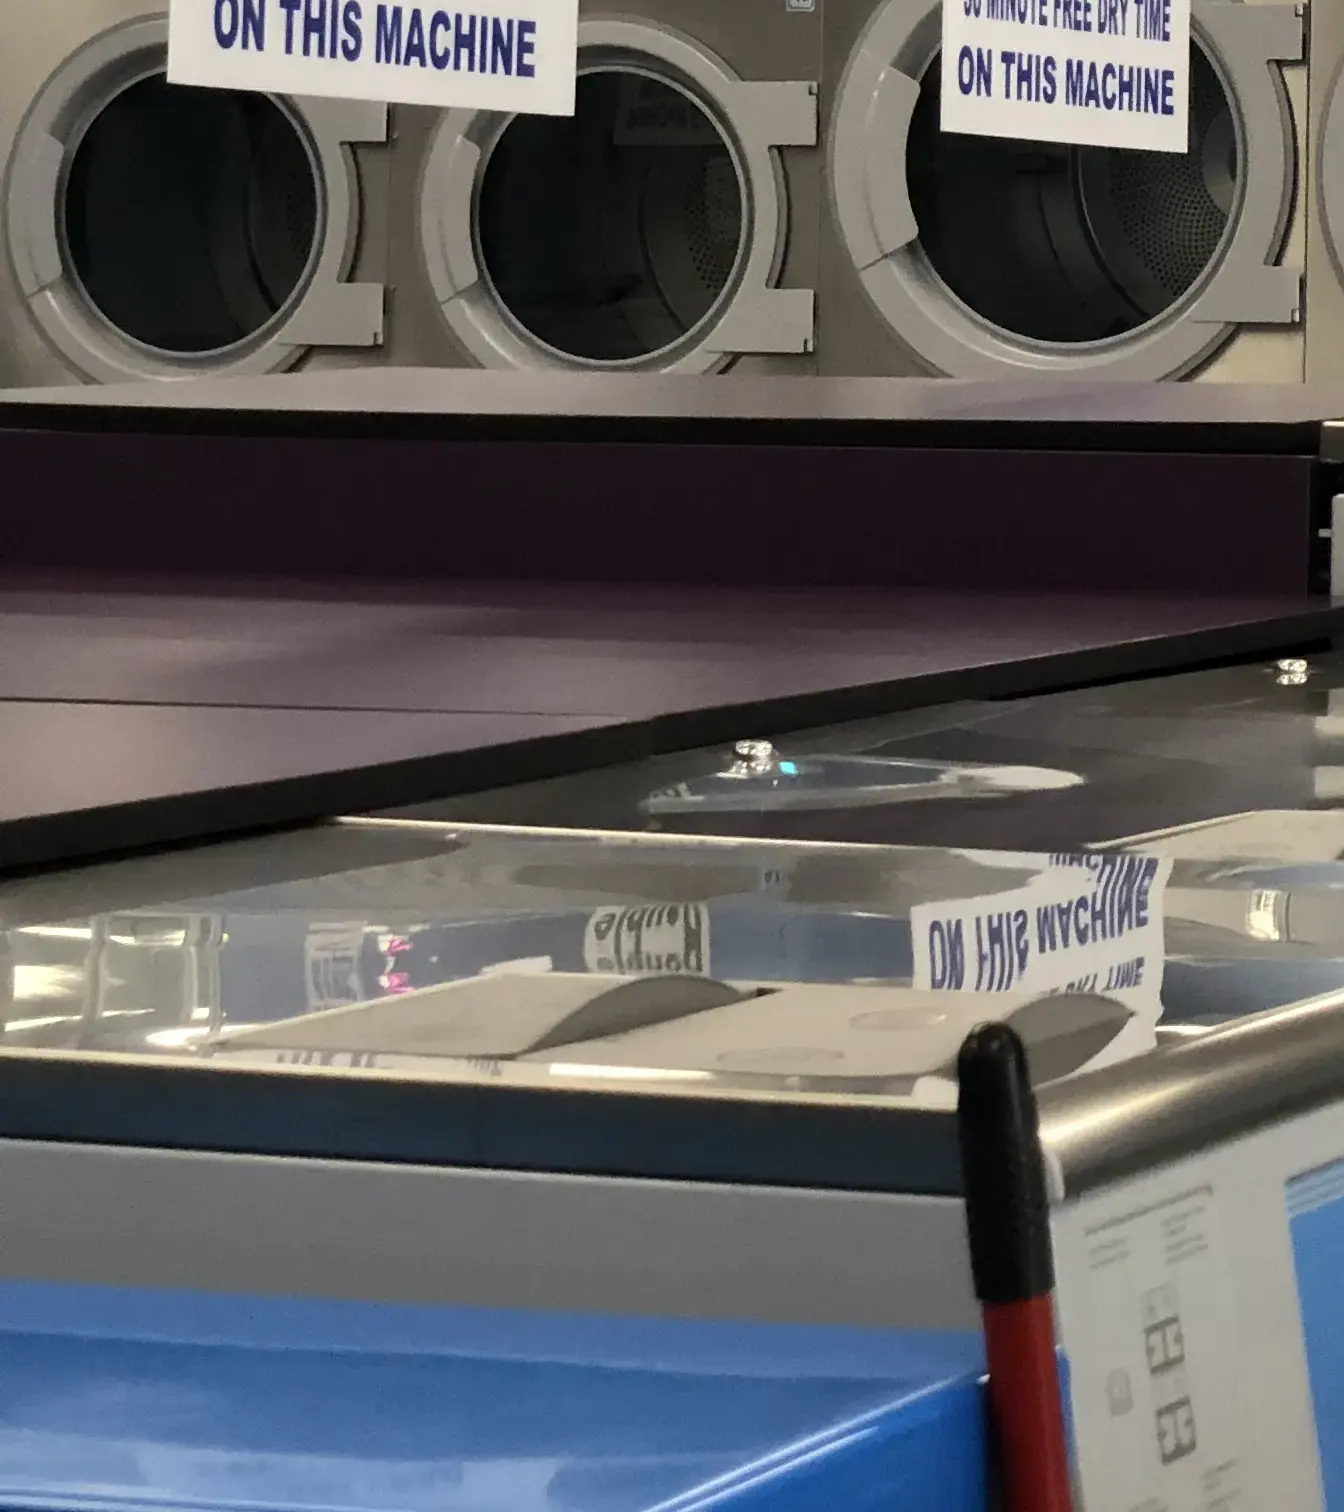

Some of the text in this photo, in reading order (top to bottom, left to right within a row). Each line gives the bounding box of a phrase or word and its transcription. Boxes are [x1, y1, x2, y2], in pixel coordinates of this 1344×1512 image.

[376, 4, 536, 77] MACHINE
[958, 45, 1174, 115] ON THIS MACHINE
